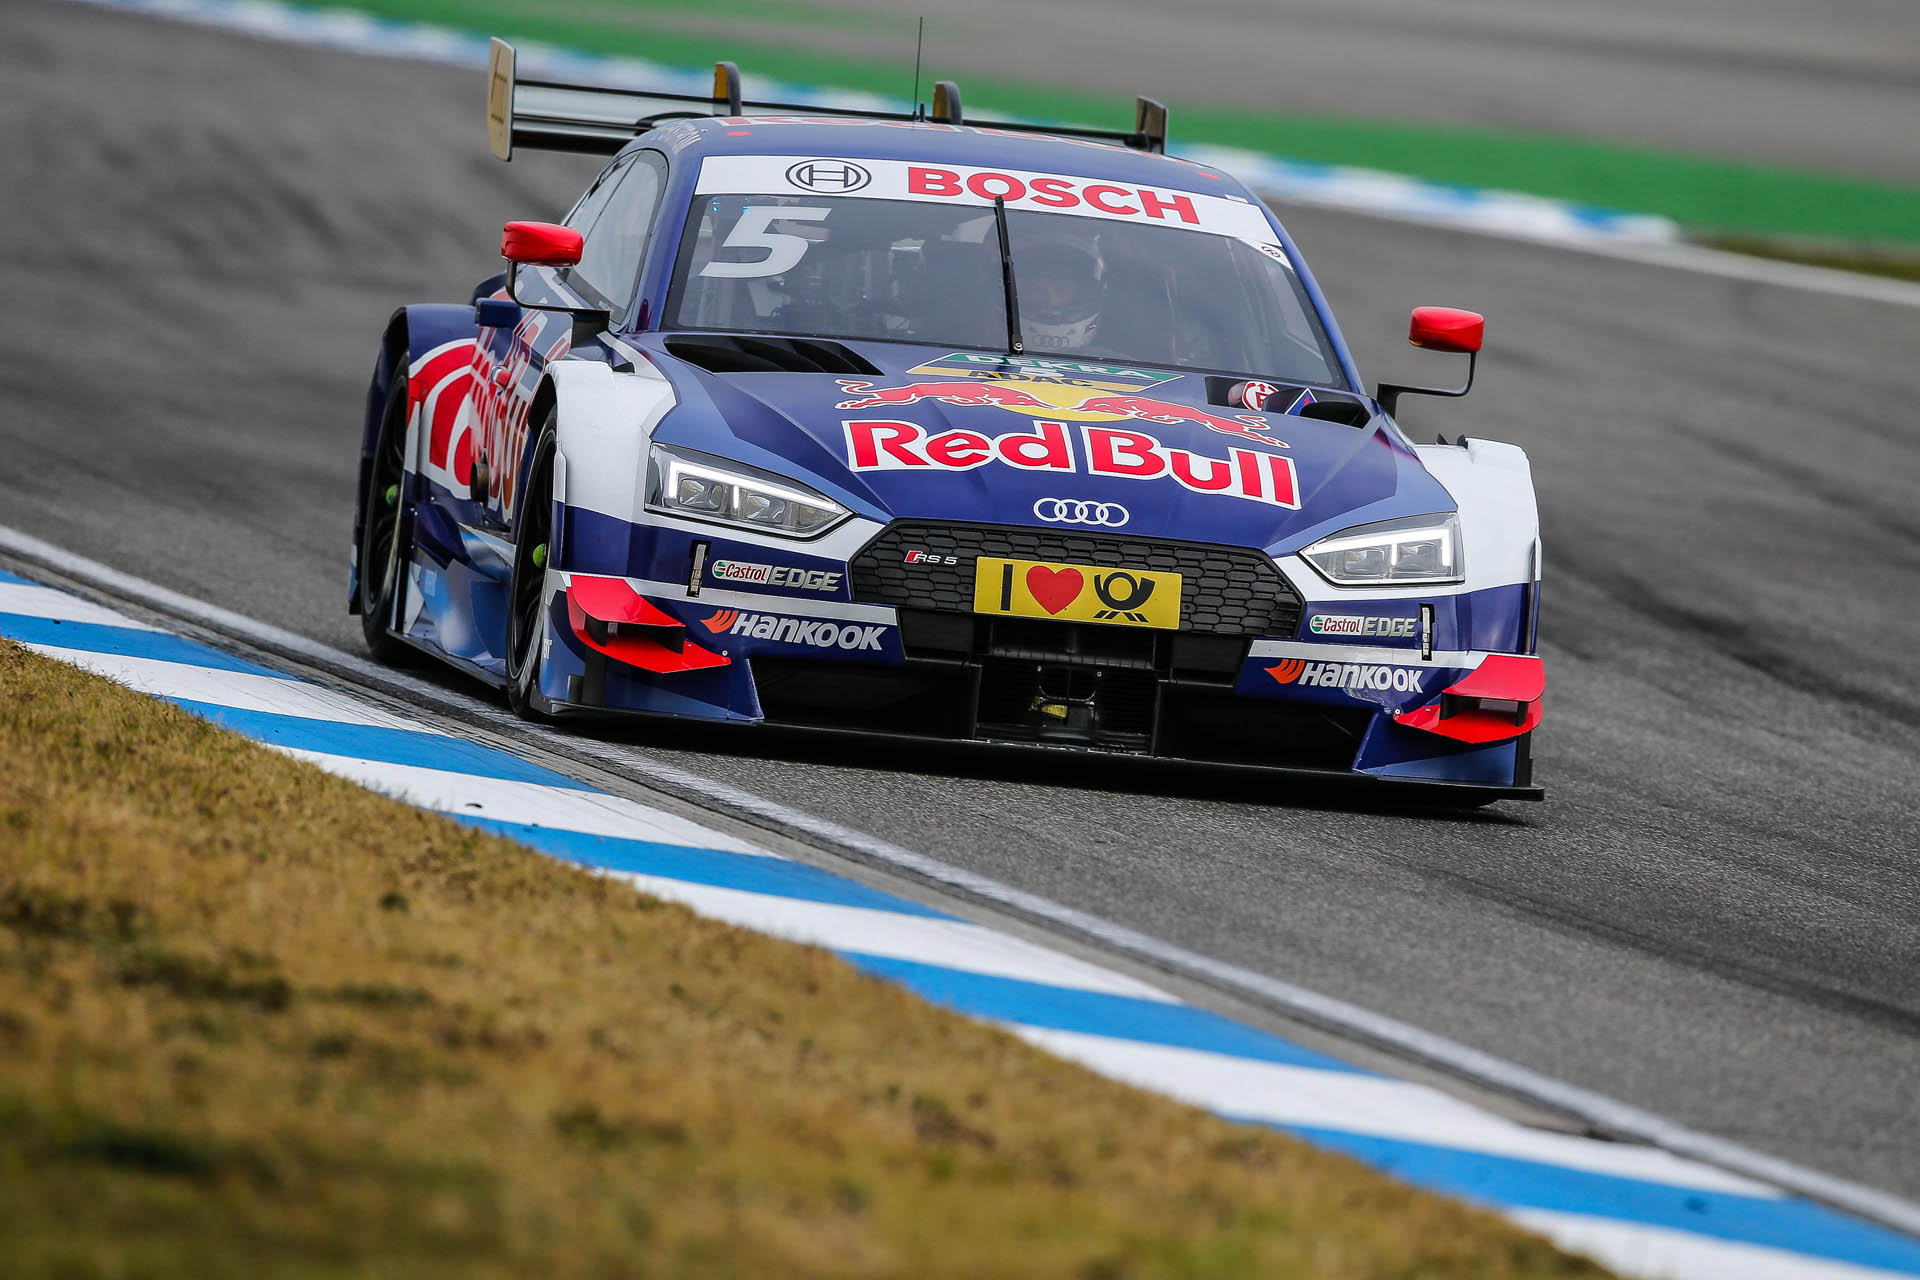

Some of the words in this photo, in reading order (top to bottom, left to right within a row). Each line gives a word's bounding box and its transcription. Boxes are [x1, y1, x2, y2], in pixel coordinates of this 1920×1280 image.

[908, 166, 1200, 225] BOSCH
[698, 205, 833, 278] 5
[964, 354, 1156, 379] DEKRA
[968, 370, 1093, 387] ADAC
[843, 420, 1075, 472] Red
[1083, 427, 1300, 509] Bull
[911, 552, 941, 563] RS
[944, 556, 958, 565] 5
[725, 562, 768, 582] Castrol
[767, 566, 844, 592] EDGE
[1323, 617, 1361, 633] Castrol
[1361, 616, 1418, 638] EDGE
